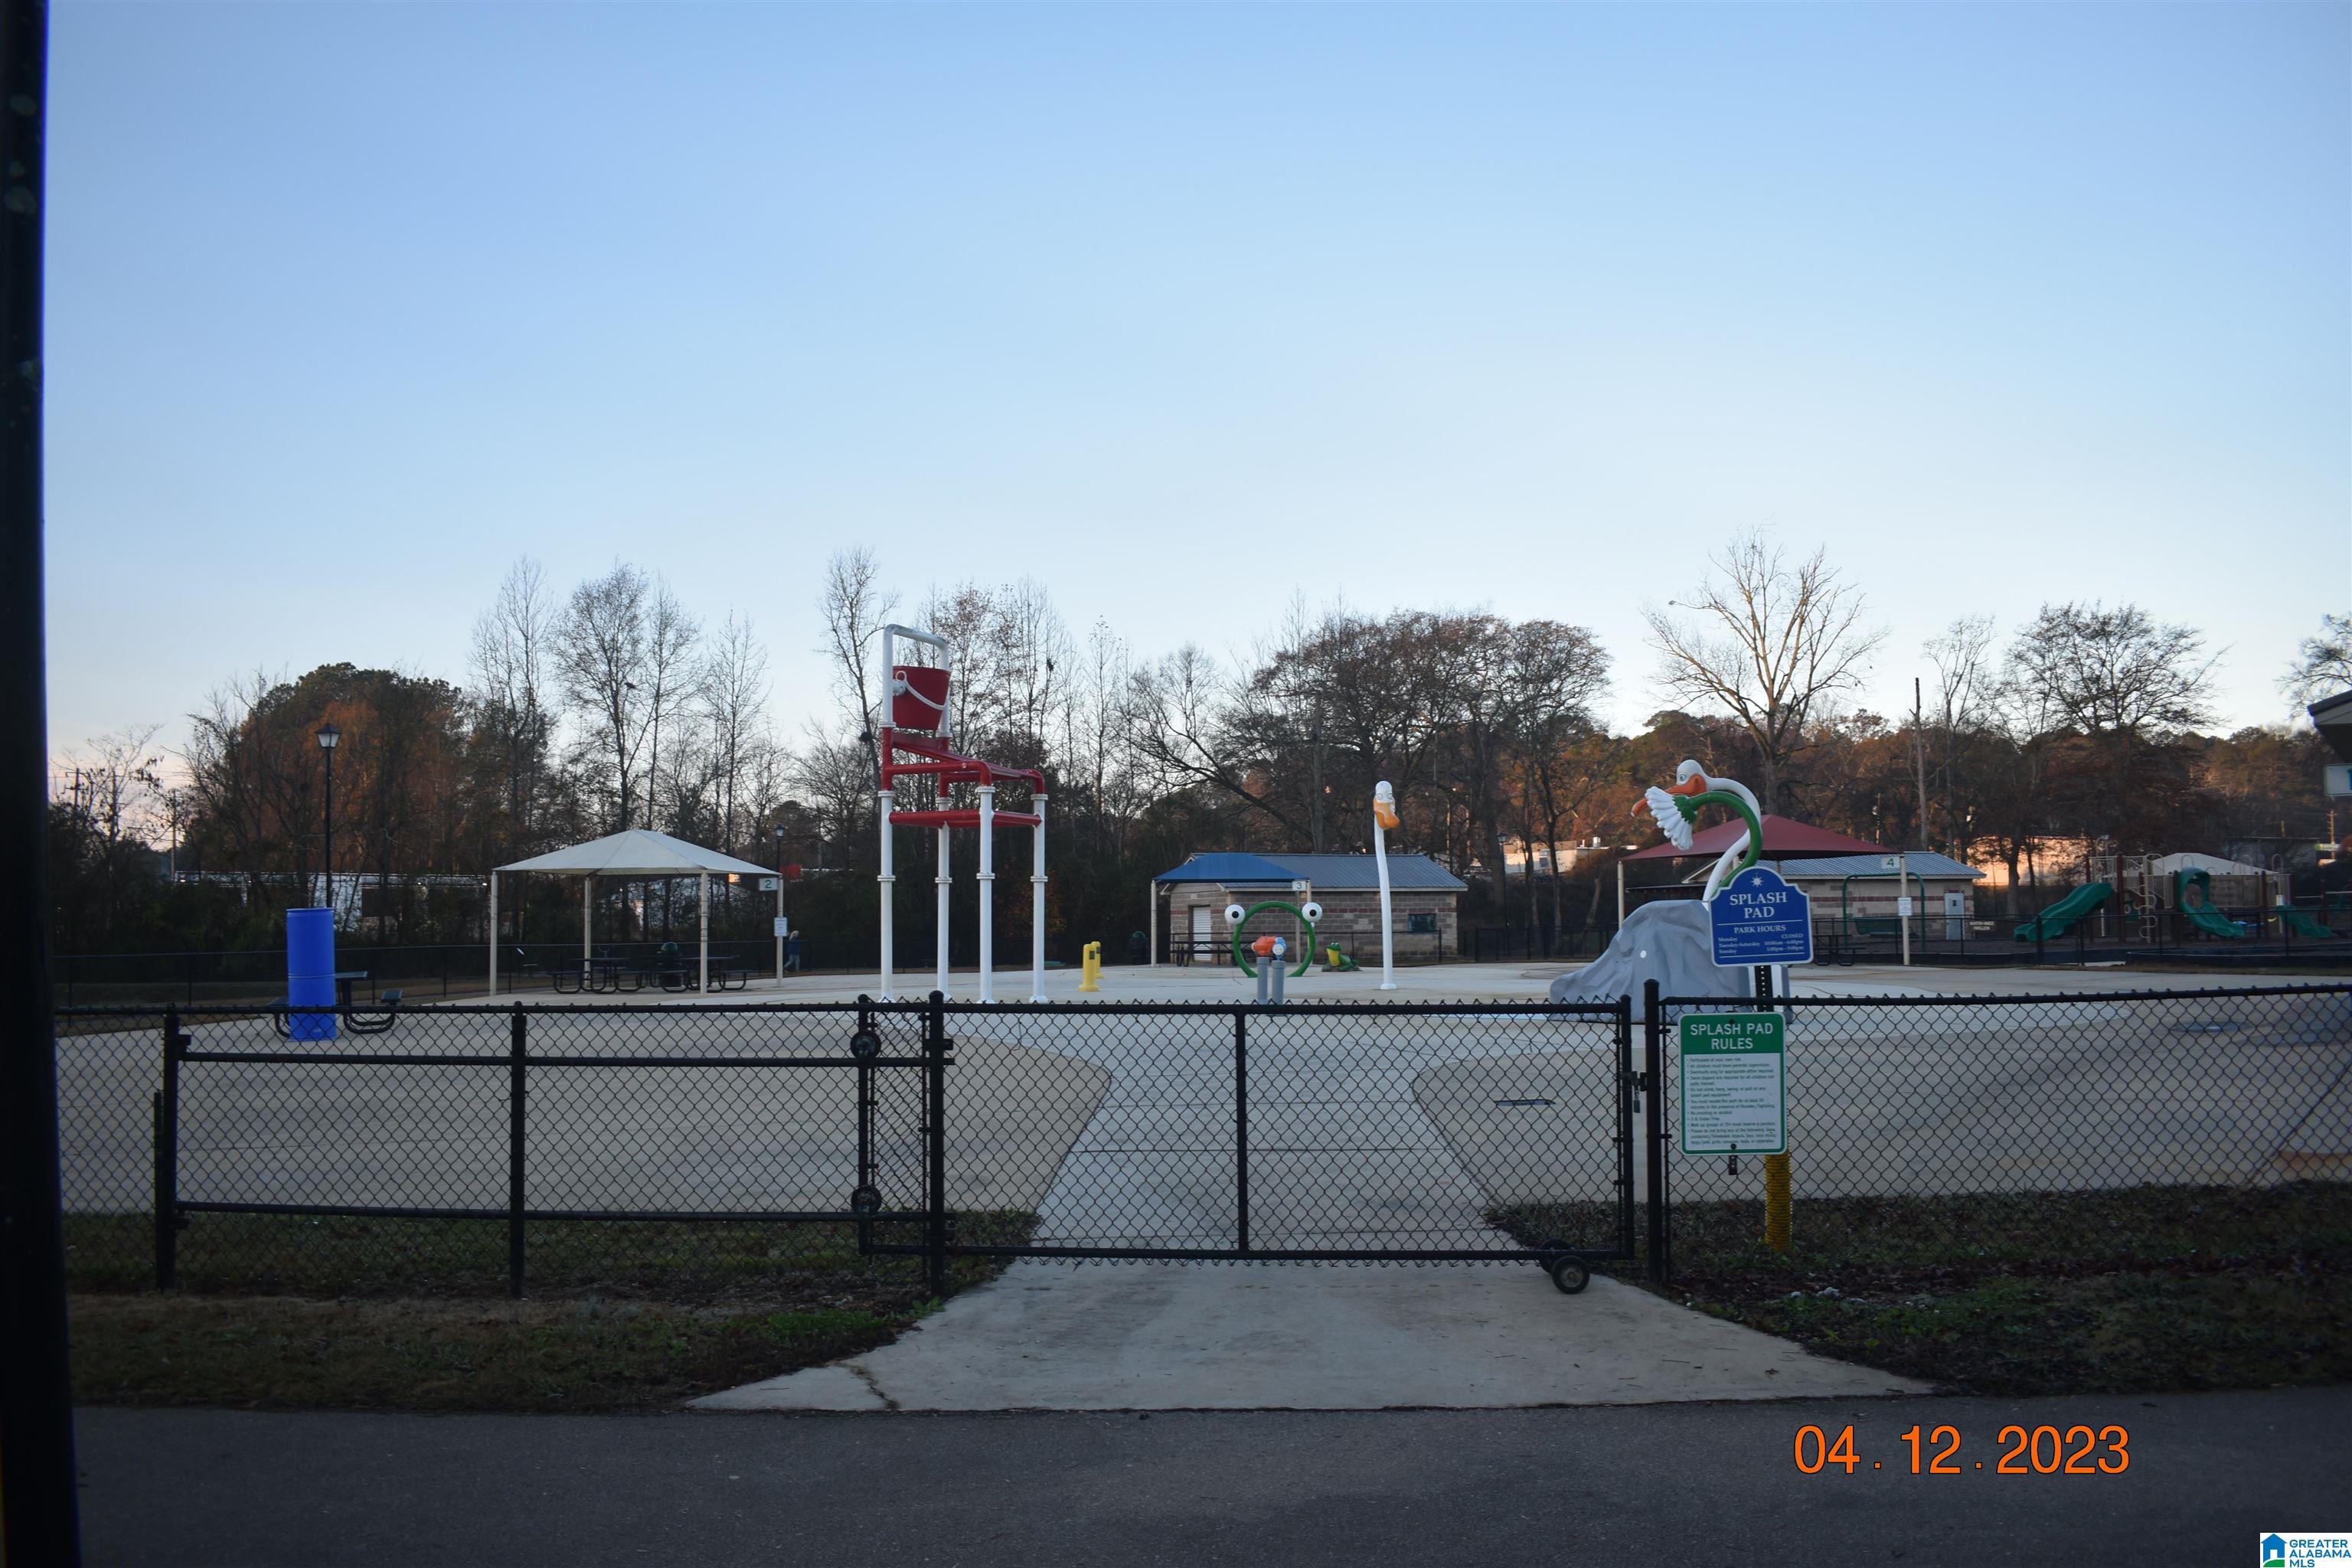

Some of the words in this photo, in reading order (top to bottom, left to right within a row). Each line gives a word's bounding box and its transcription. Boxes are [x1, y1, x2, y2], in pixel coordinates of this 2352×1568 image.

[1886, 858, 1895, 867] 4
[765, 880, 772, 889] 2
[1730, 892, 1788, 906] SPLASH
[1744, 906, 1775, 918] PAD
[1690, 1023, 1741, 1035] SPLASH
[1747, 1023, 1773, 1034] PAD
[1712, 1038, 1753, 1049] RULES
